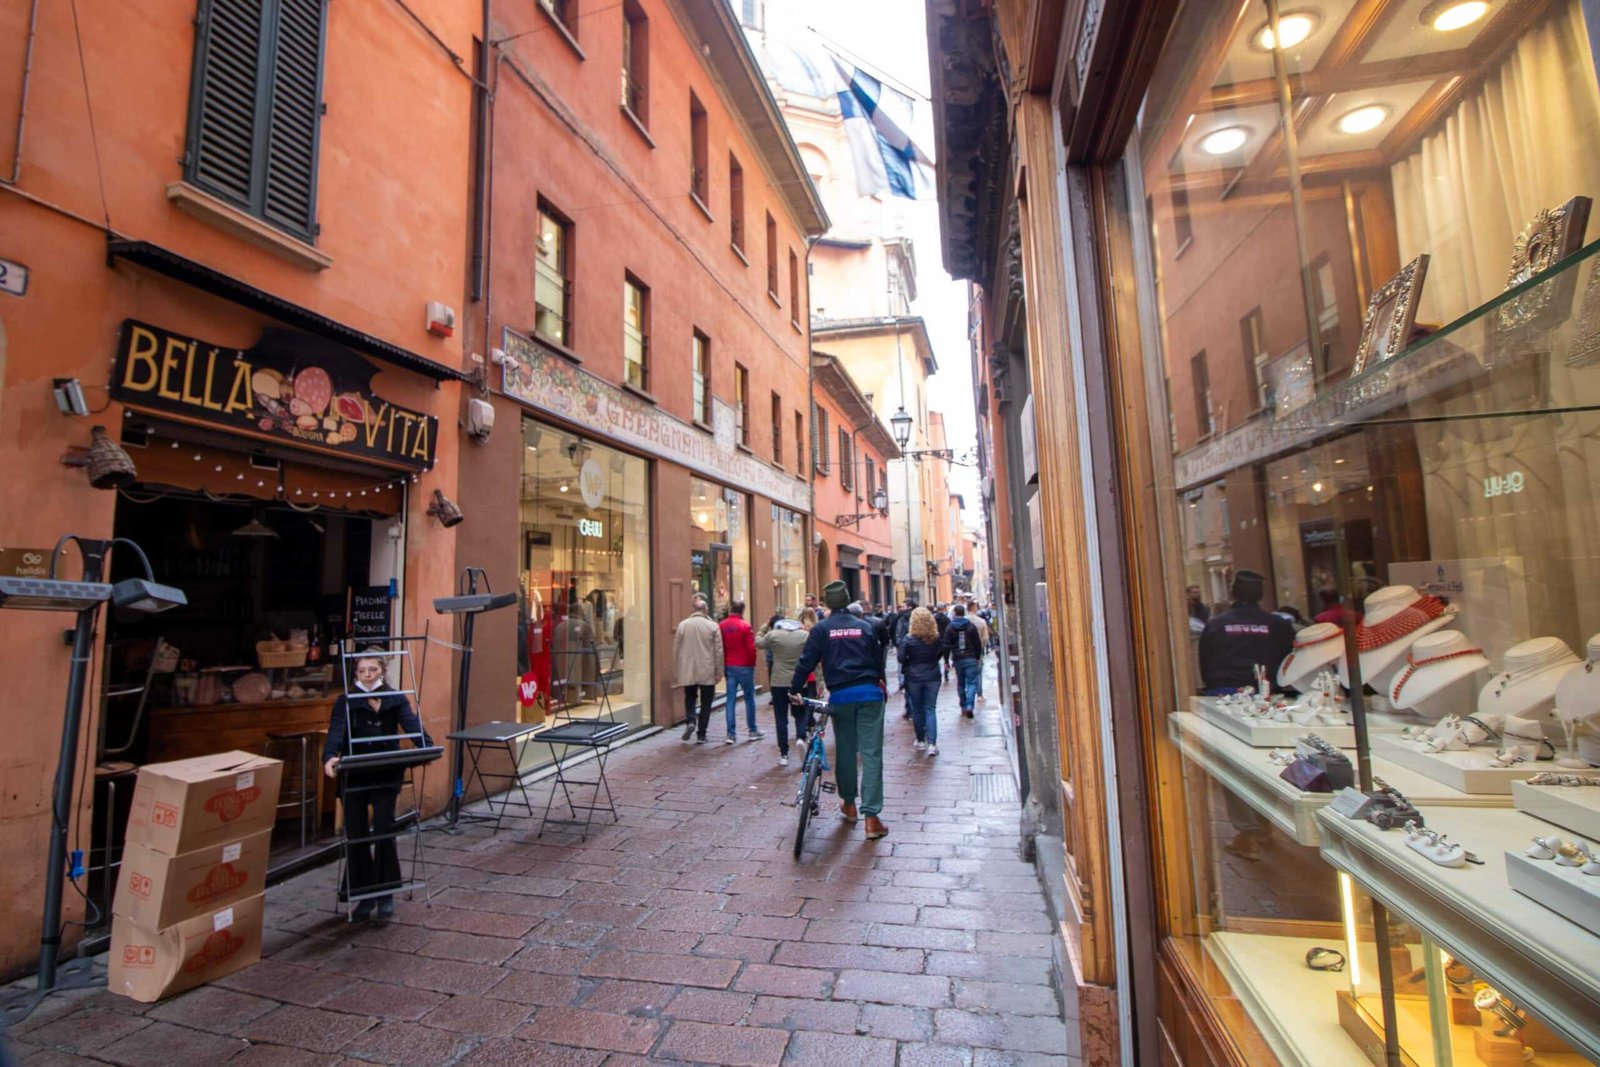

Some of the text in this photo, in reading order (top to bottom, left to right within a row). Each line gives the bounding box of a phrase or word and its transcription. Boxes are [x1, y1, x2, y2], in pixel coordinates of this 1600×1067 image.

[122, 325, 428, 461] BELLA VITA
[521, 681, 537, 699] WP
